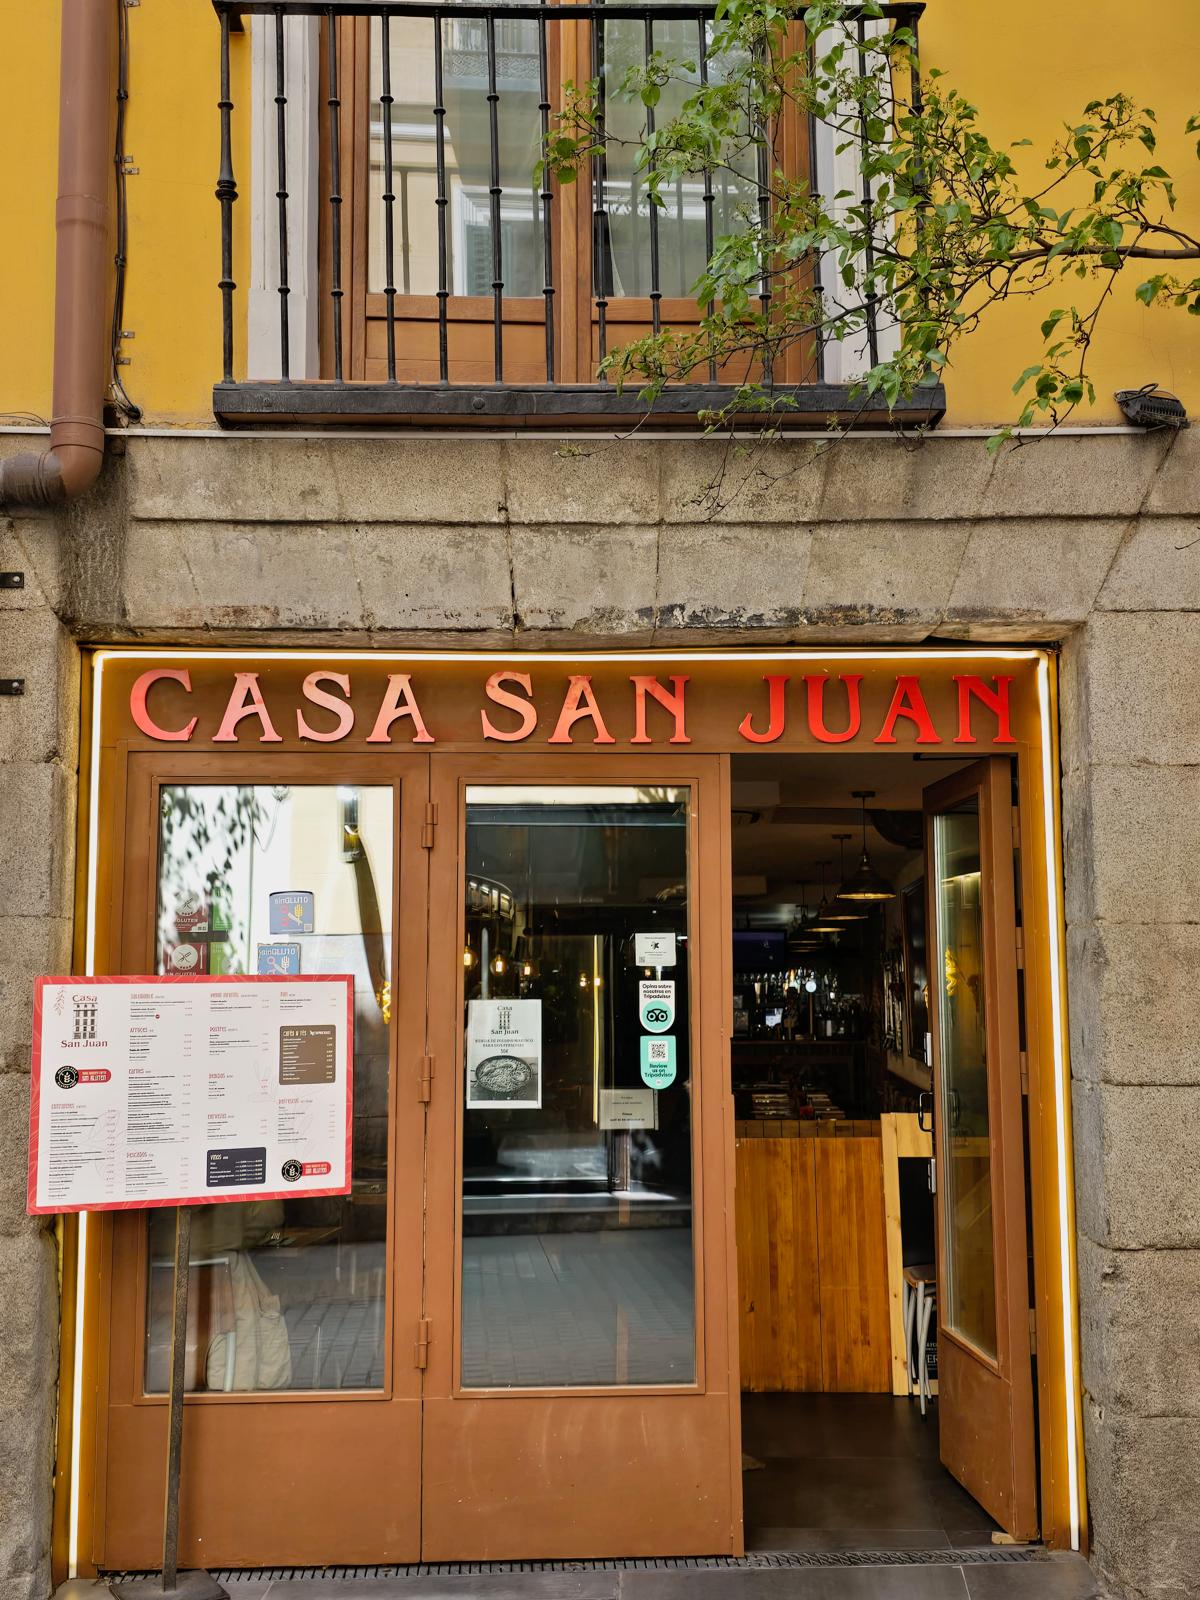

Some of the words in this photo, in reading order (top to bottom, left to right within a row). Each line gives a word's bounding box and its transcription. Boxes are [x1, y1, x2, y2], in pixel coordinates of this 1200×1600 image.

[130, 668, 436, 743] CASA
[481, 671, 692, 744] SAN
[738, 674, 1017, 744] JUAN
[72, 994, 98, 1002] Casa
[60, 1040, 80, 1048] San
[82, 1040, 108, 1048] Juan
